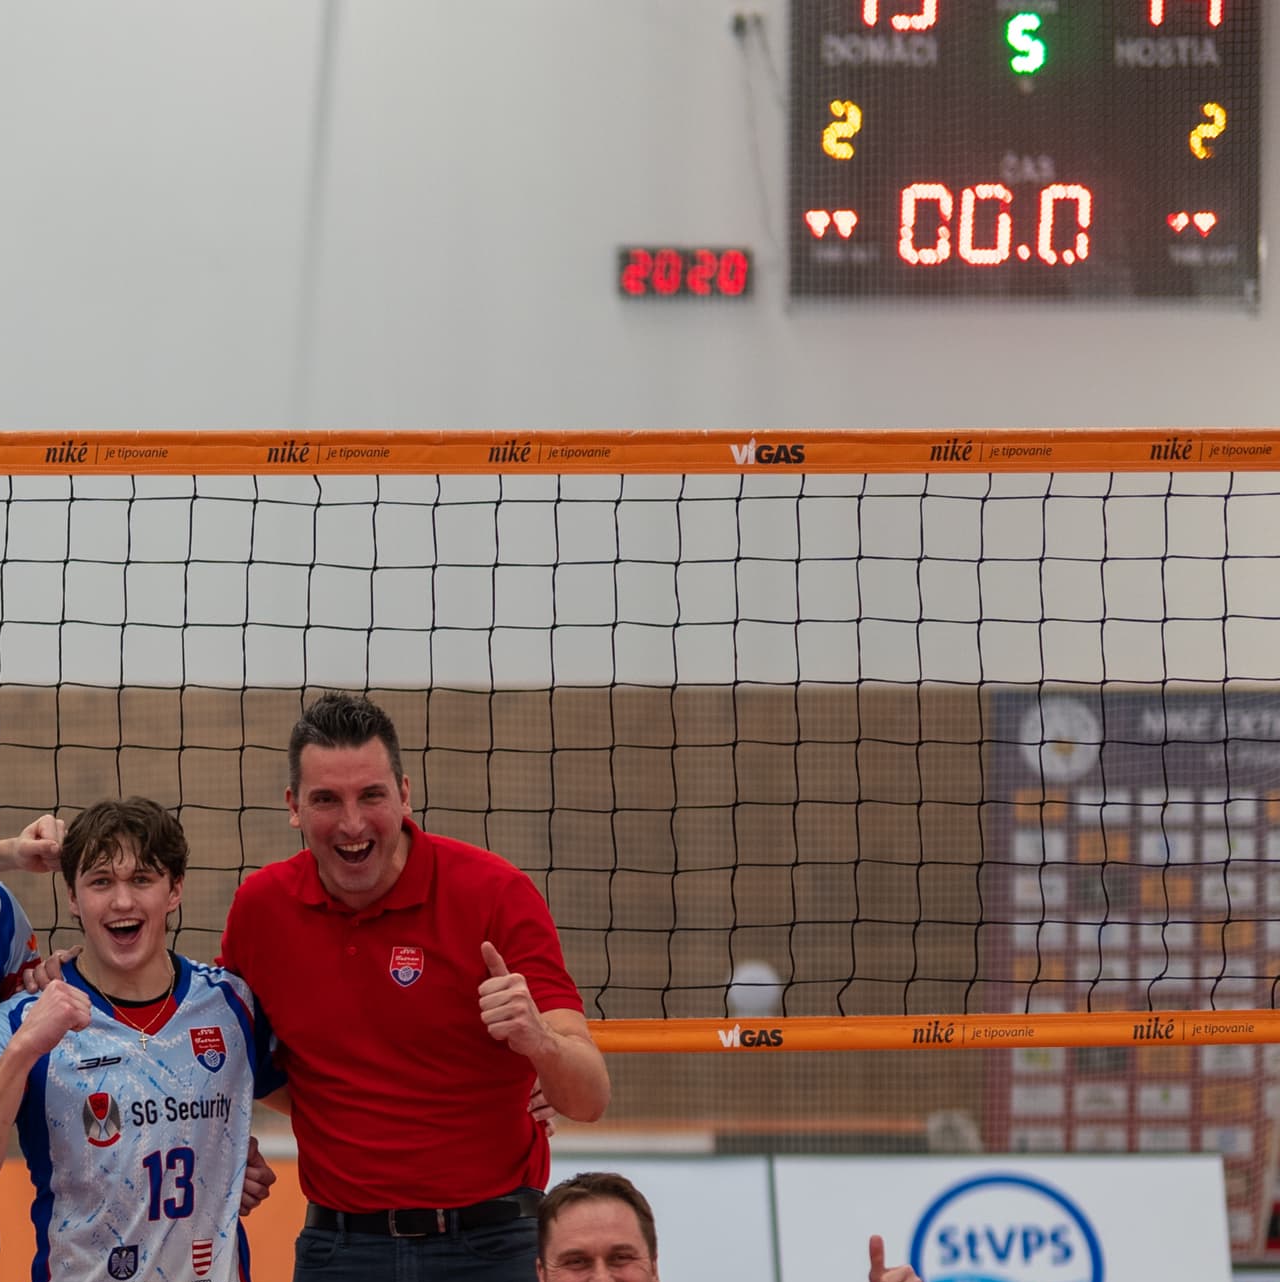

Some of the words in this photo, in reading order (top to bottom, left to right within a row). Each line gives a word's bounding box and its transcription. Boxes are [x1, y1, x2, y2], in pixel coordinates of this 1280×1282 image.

[46, 440, 87, 463] niké
[105, 447, 115, 461] je
[118, 446, 169, 461] tipovanie
[268, 440, 309, 463] niké
[326, 447, 337, 461] je
[340, 446, 390, 461] tipovanie
[489, 440, 530, 462] niké
[548, 447, 558, 461] je
[561, 446, 611, 461] tipovanie
[931, 438, 972, 461] niké
[989, 445, 1000, 459] je
[1002, 444, 1052, 459] tipovanie
[1151, 437, 1192, 460] niké
[1209, 444, 1219, 458] je
[1223, 443, 1272, 458] tipovanie
[912, 1021, 954, 1043] niké
[971, 1026, 981, 1039] je
[984, 1025, 1034, 1039] tipovanie
[1132, 1017, 1174, 1040] niké
[1192, 1022, 1202, 1036] je
[1205, 1022, 1254, 1035] tipovanie
[131, 1099, 159, 1127] SG
[164, 1092, 232, 1124] Security
[142, 1147, 195, 1222] 13
[937, 1223, 1074, 1265] StVPS
